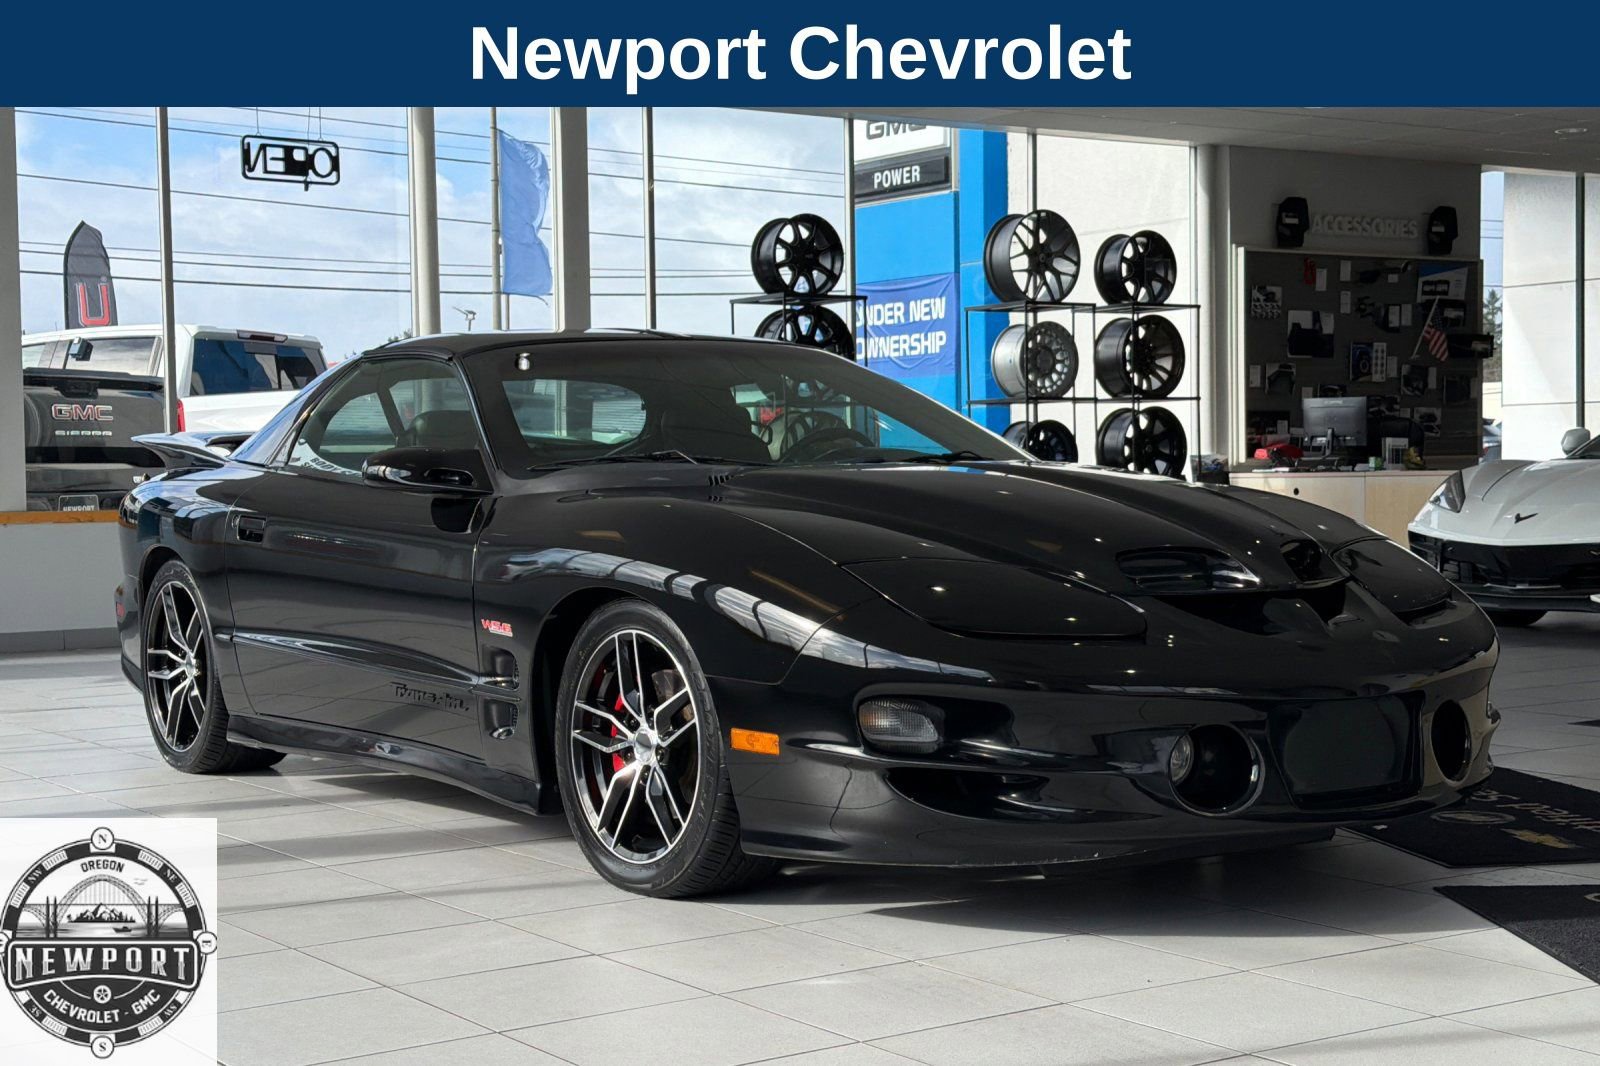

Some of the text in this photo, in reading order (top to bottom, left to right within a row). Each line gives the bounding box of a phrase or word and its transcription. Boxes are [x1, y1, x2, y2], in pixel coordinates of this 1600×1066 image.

[873, 165, 921, 189] POWER
[1311, 214, 1419, 239] ACCESSORIES
[909, 297, 946, 323] NEW
[855, 331, 947, 360] OWNERSHIP
[52, 403, 113, 421] GMC
